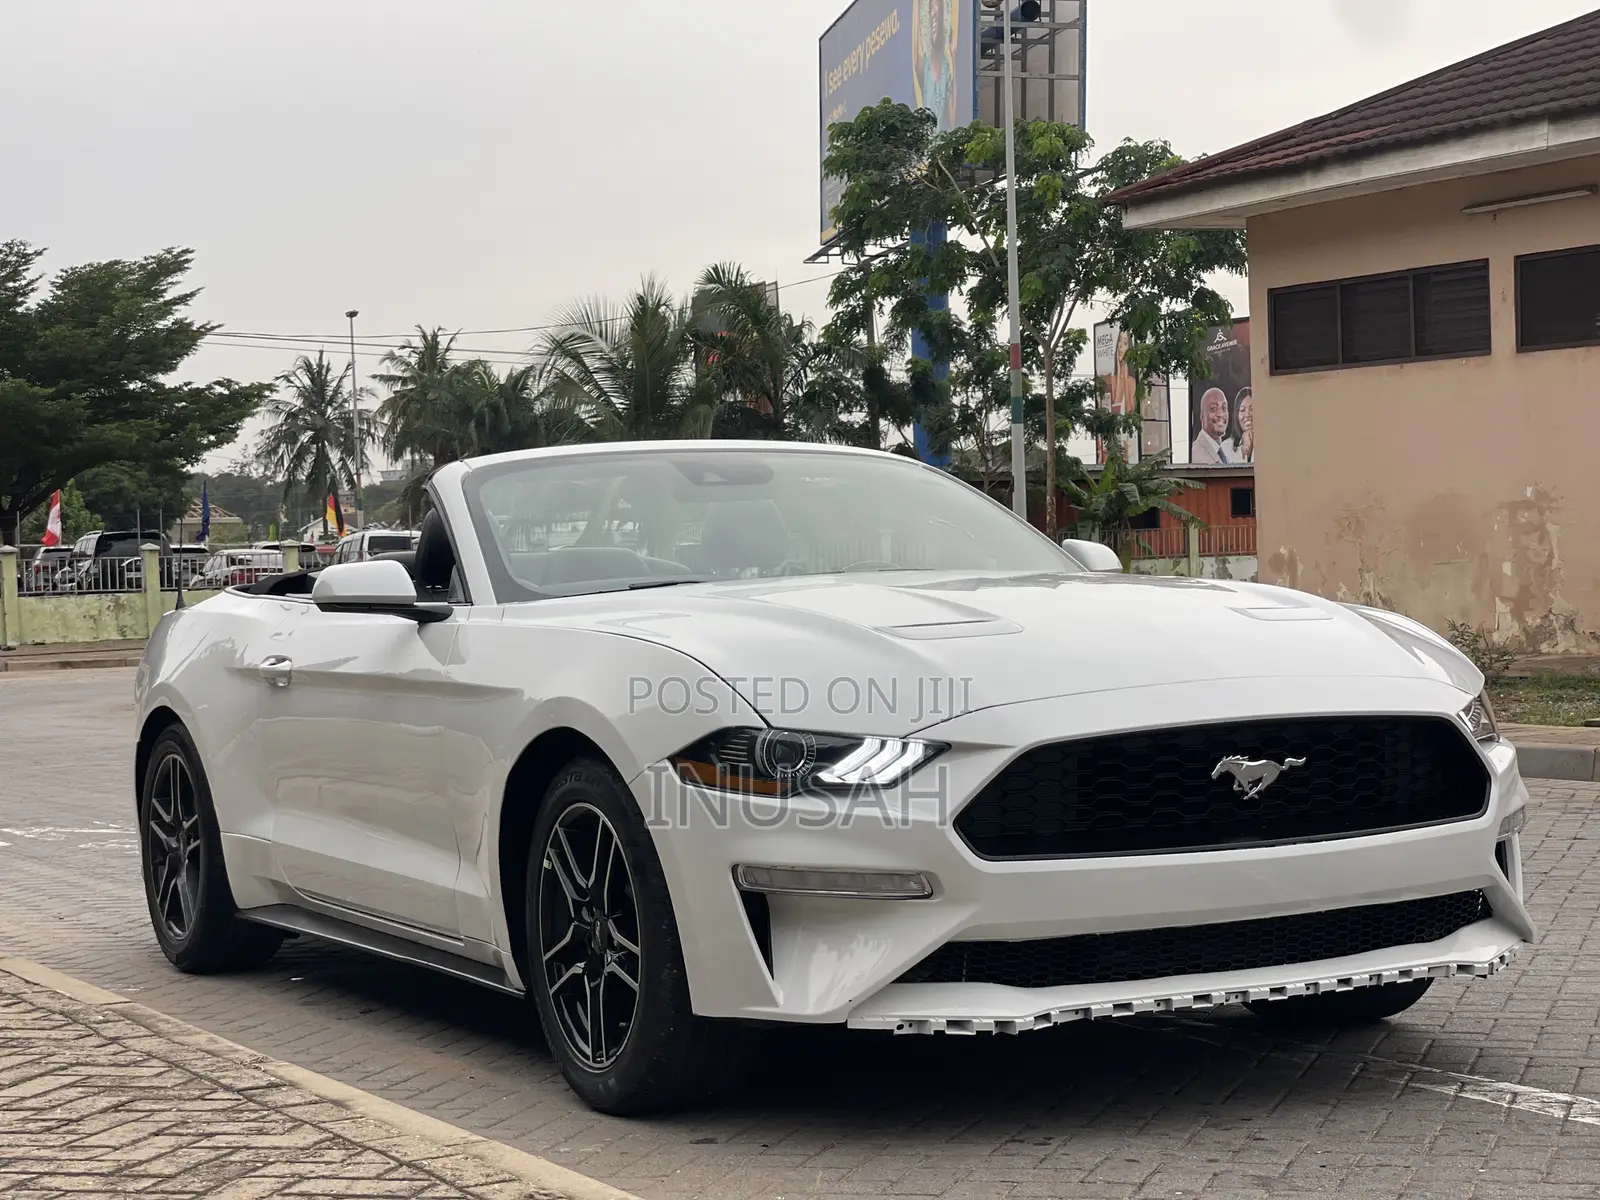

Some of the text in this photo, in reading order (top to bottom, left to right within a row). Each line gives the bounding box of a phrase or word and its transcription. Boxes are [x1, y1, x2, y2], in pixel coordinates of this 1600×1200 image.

[828, 64, 842, 95] see
[843, 41, 865, 81] every
[866, 8, 900, 69] pesewa.
[1097, 333, 1113, 346] MEGA
